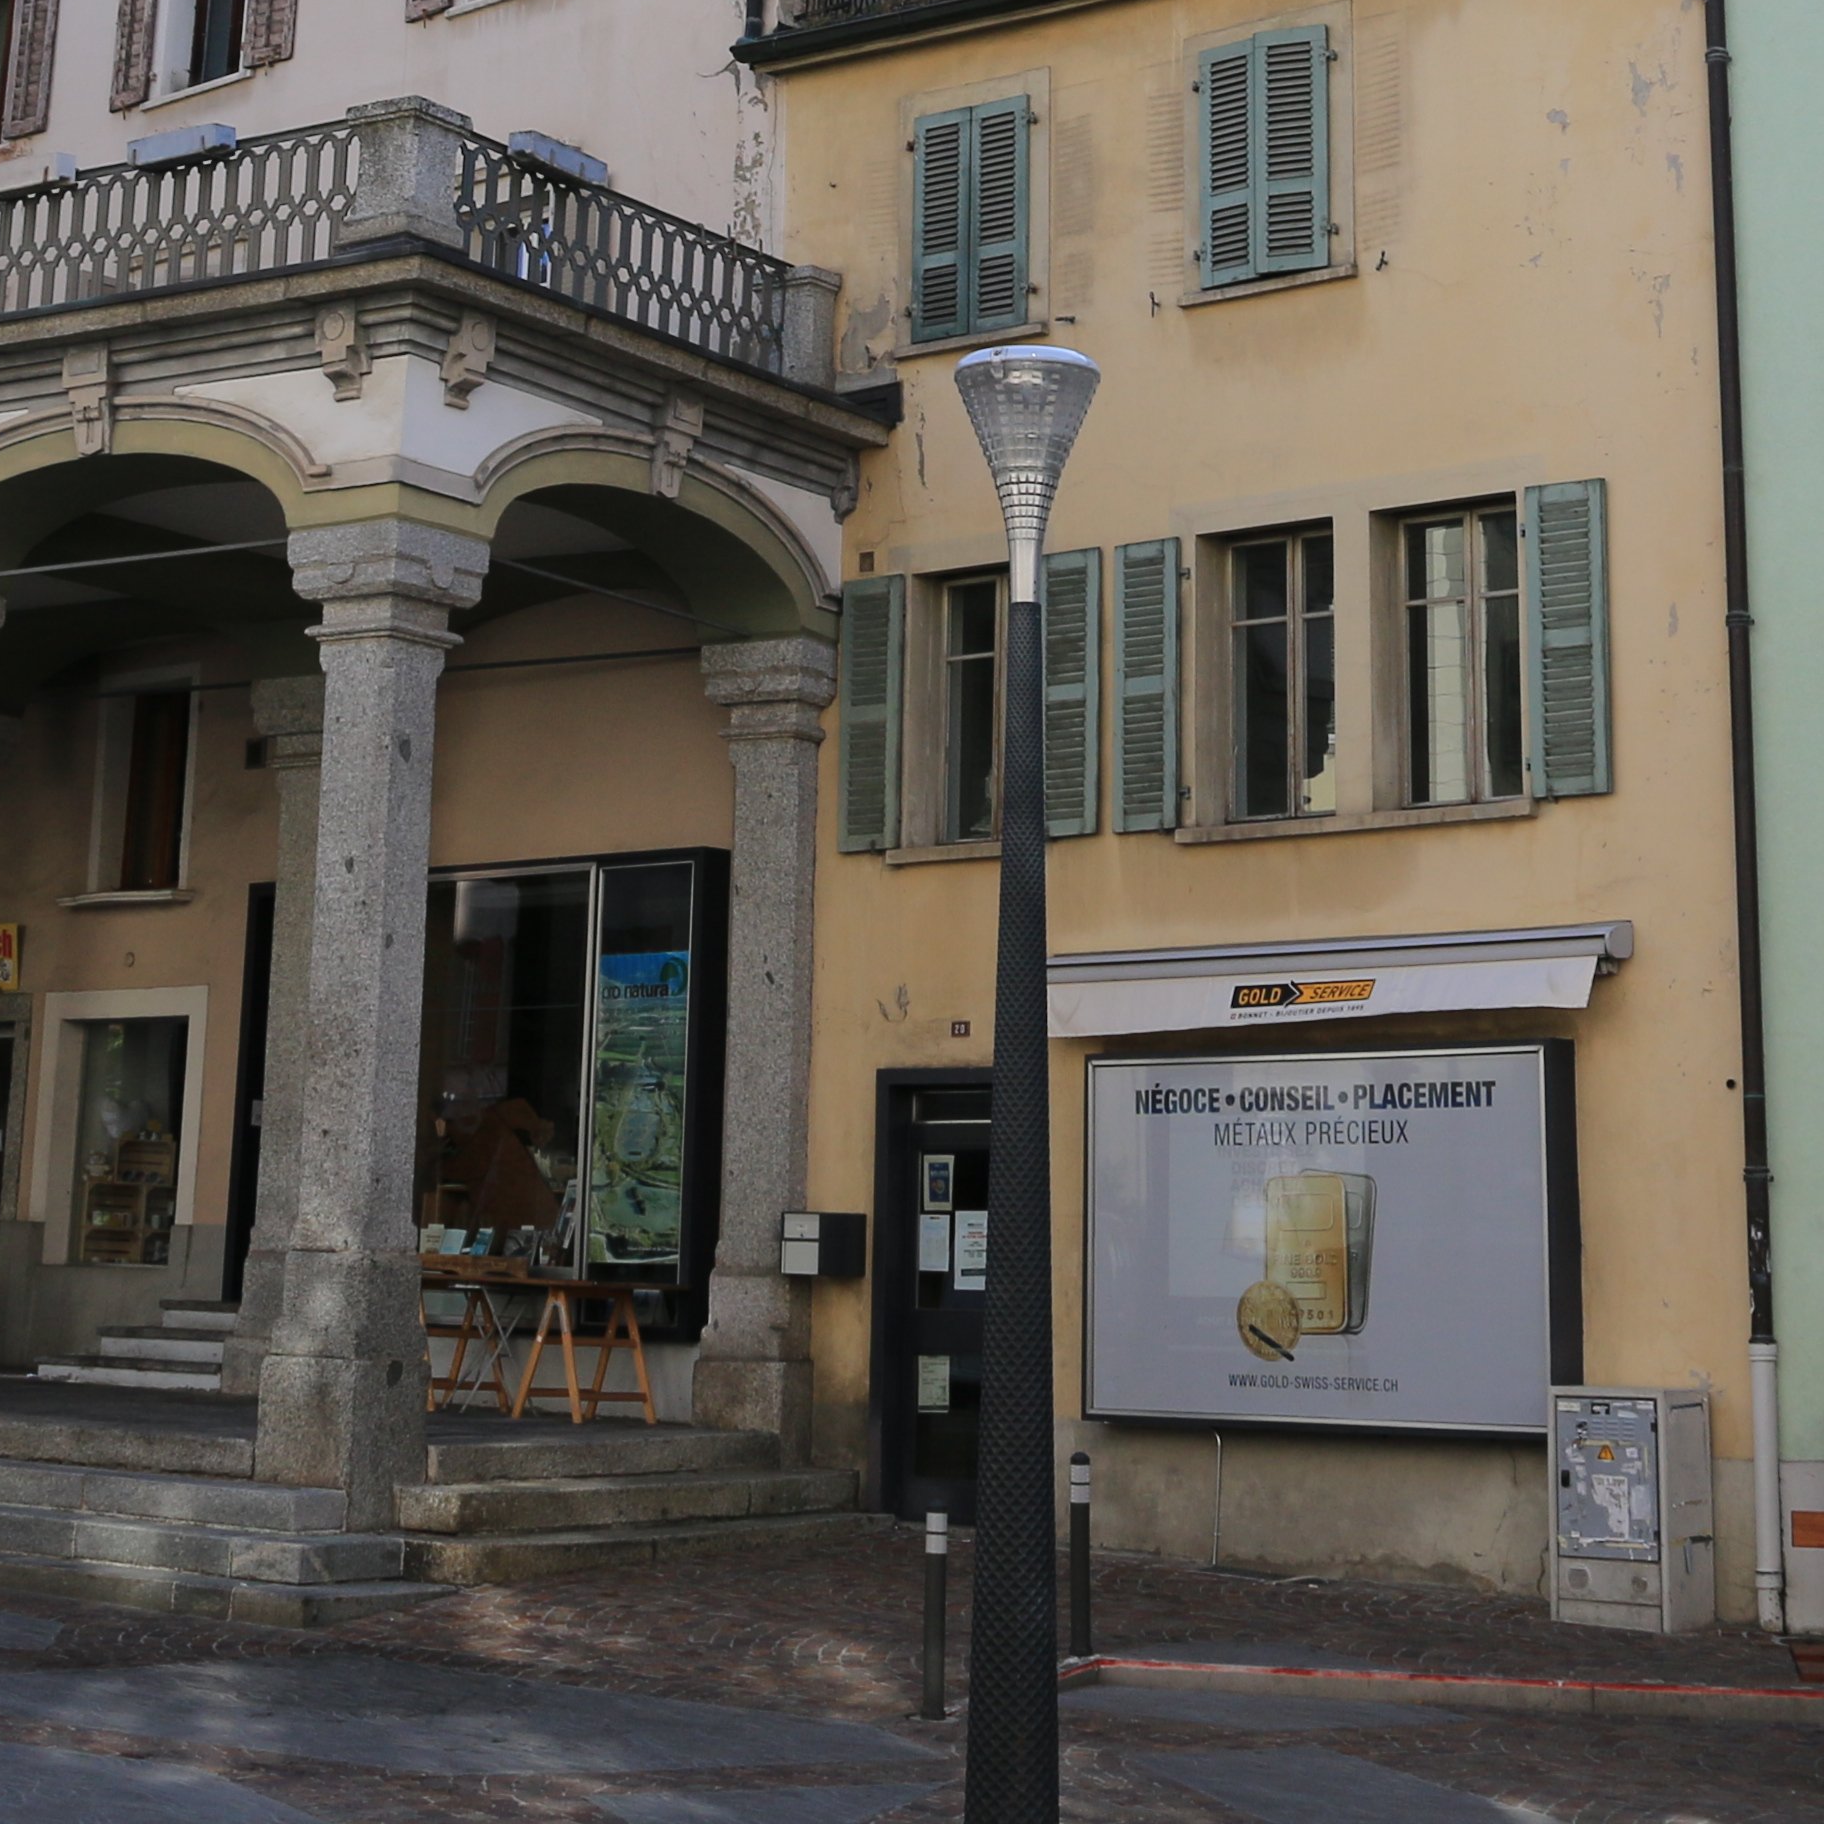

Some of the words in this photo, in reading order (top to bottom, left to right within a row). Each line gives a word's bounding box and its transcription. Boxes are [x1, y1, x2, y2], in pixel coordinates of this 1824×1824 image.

[623, 982, 670, 999] natura
[1238, 987, 1282, 1006] GOLD
[1309, 983, 1371, 1000] SERVICE
[1237, 1011, 1268, 1020] BONNET
[1276, 1008, 1314, 1018] BIJOUTIER
[1317, 1006, 1344, 1015] DEPUIS
[954, 1024, 966, 1035] 20
[1135, 1082, 1221, 1115] NÉGOCE
[1239, 1084, 1335, 1113] CONSEIL
[1353, 1080, 1496, 1110] PLACEMENT
[1213, 1118, 1297, 1147] MÉTAUX
[1305, 1116, 1409, 1145] PRÉCIEUX
[1228, 1374, 1399, 1392] WWW.GOLD-SWISS-SERVICE.CH
